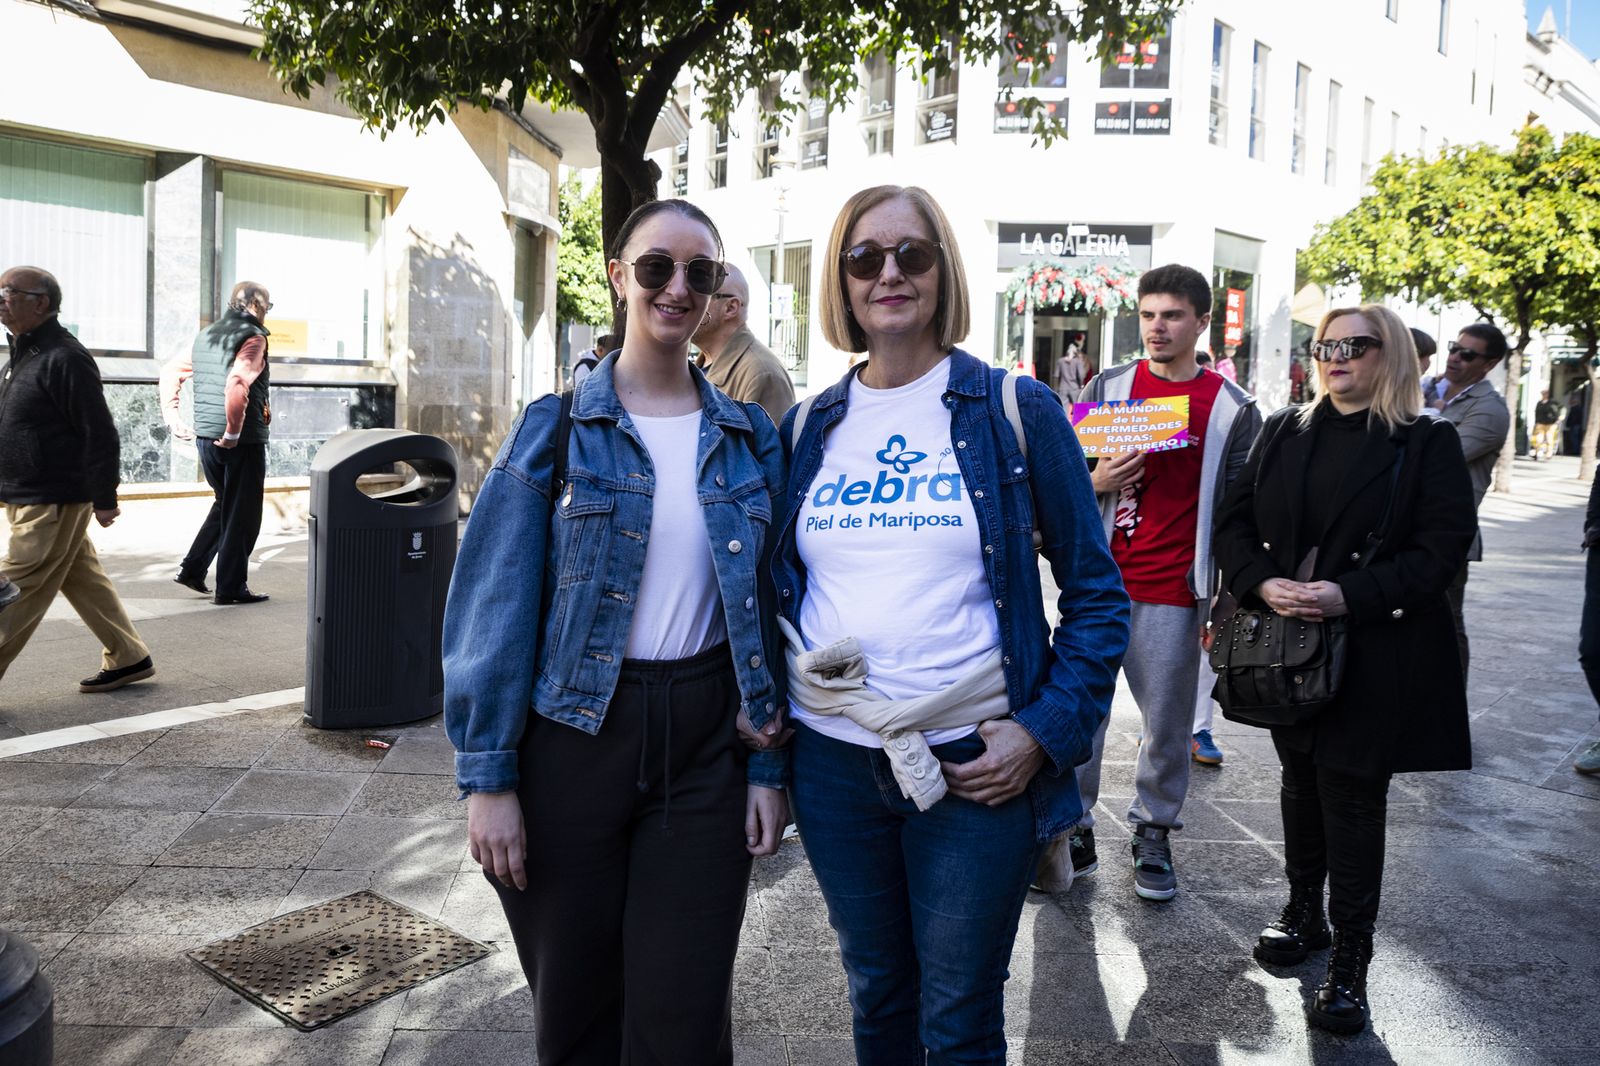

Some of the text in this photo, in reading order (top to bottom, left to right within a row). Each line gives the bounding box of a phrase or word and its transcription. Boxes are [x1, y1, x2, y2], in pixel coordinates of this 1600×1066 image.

[1020, 232, 1130, 257] LA GALERIA
[1088, 404, 1173, 416] DÍA MUNDIAL
[1112, 415, 1149, 424] de las
[1079, 420, 1183, 434] ENFERMEDADES
[1106, 434, 1153, 443] RARAS:
[1082, 445, 1097, 454] 29
[1100, 445, 1116, 453] de
[812, 470, 962, 508] debra
[806, 511, 963, 532] Piel de Mariposa
